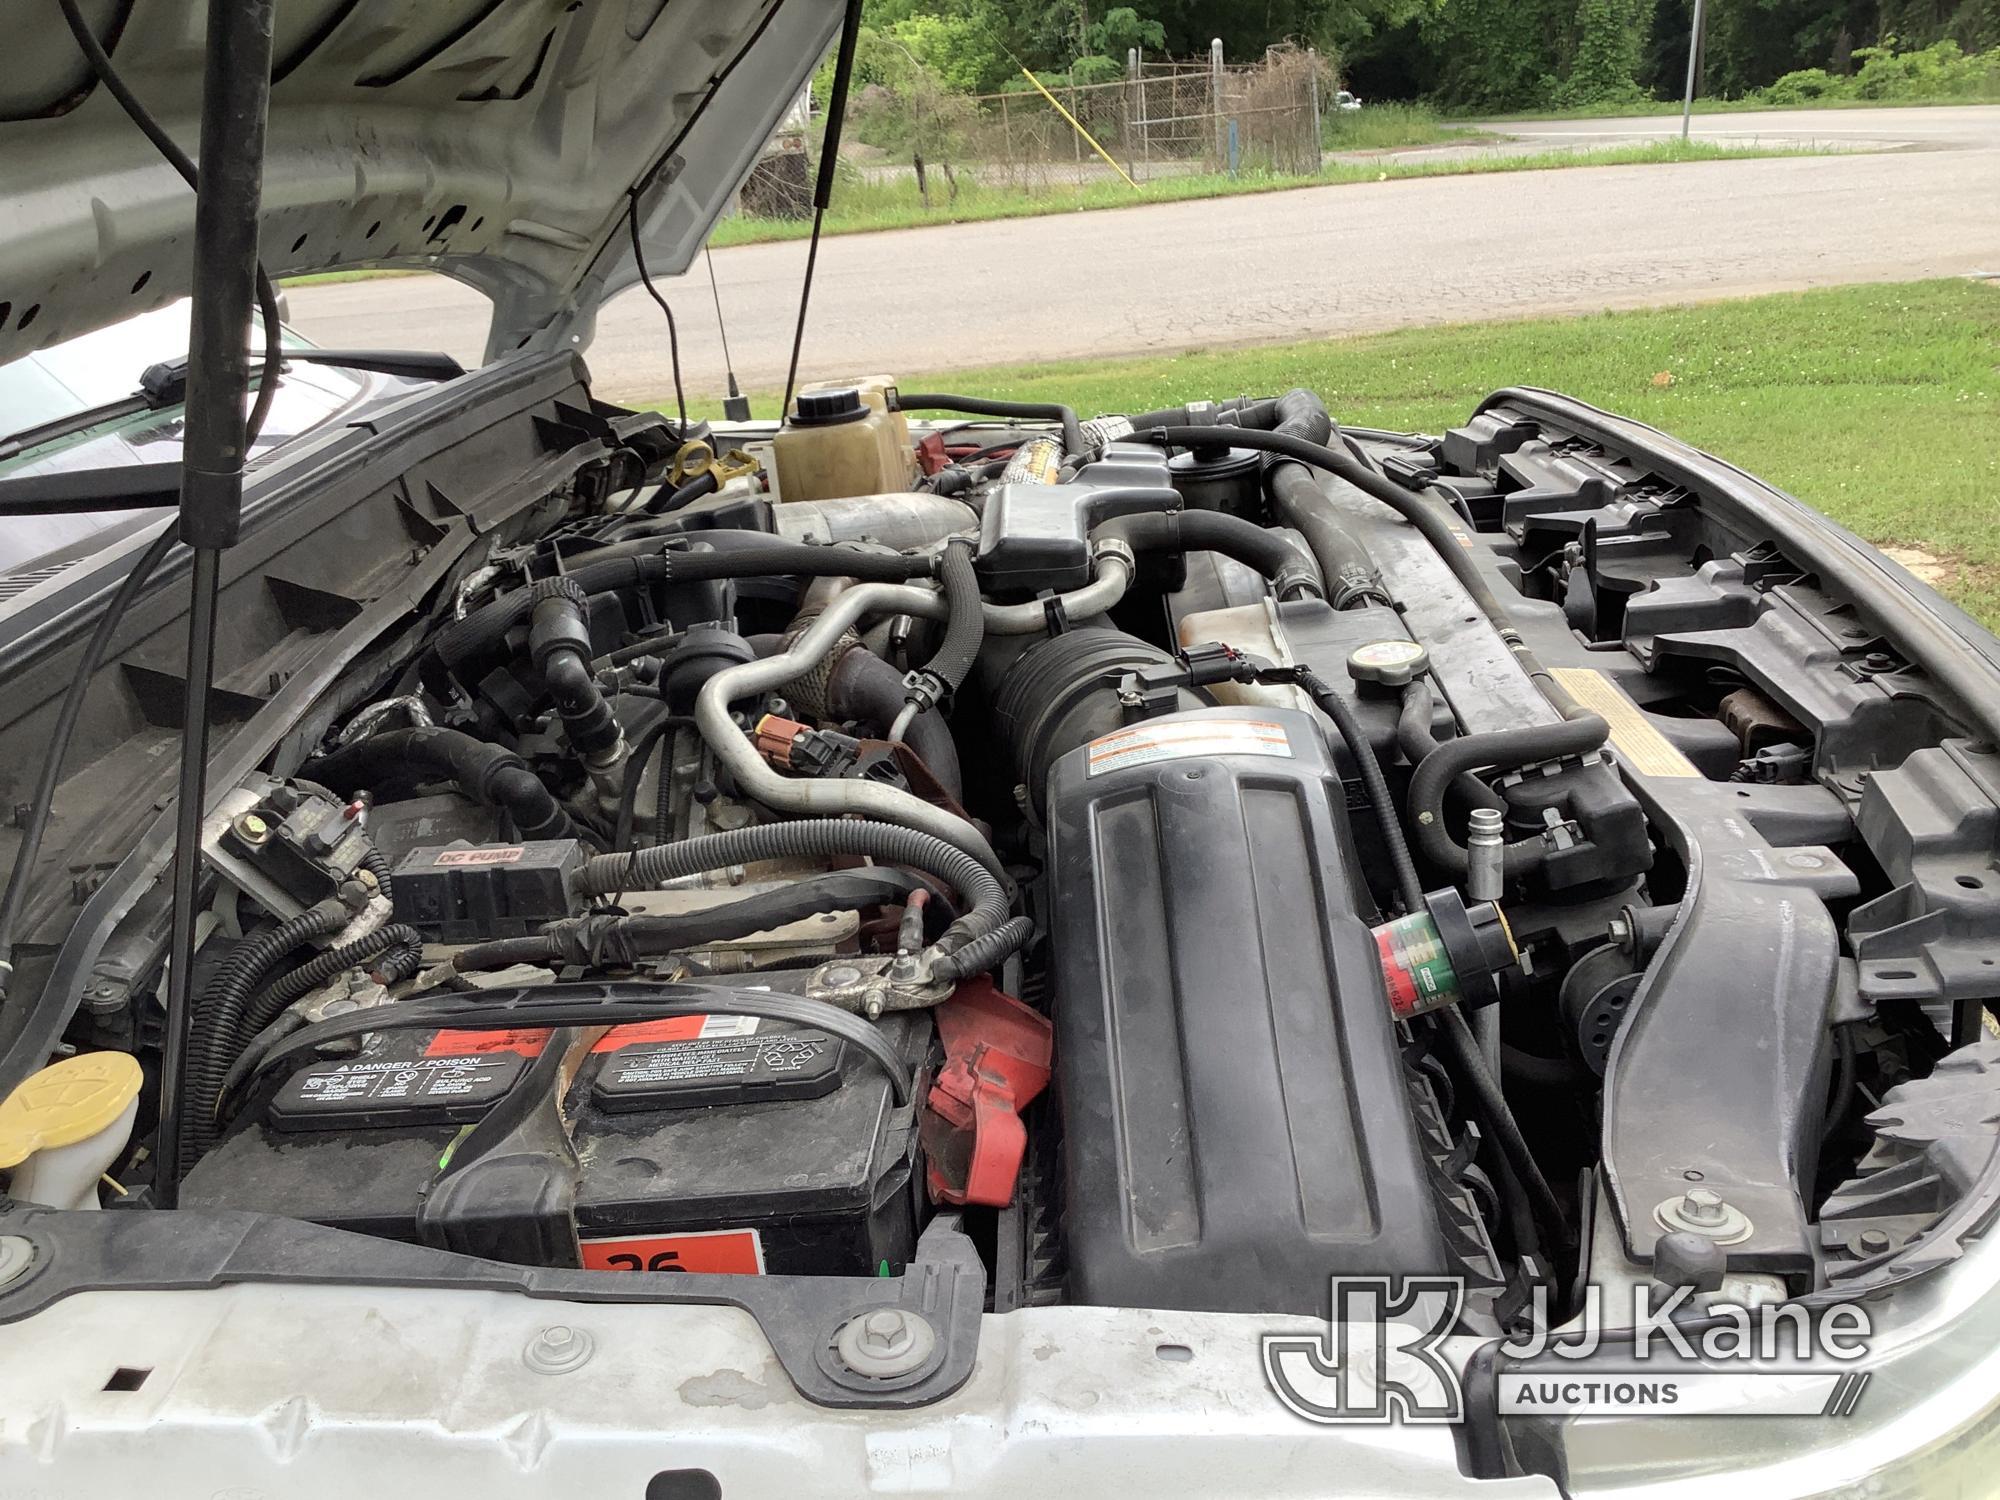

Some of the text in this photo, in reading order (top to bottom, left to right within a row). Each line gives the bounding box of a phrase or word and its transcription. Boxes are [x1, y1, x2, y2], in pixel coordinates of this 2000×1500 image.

[439, 851, 520, 862] DC PUMP
[351, 1061, 412, 1072] DANGER
[425, 1057, 481, 1067] POISON
